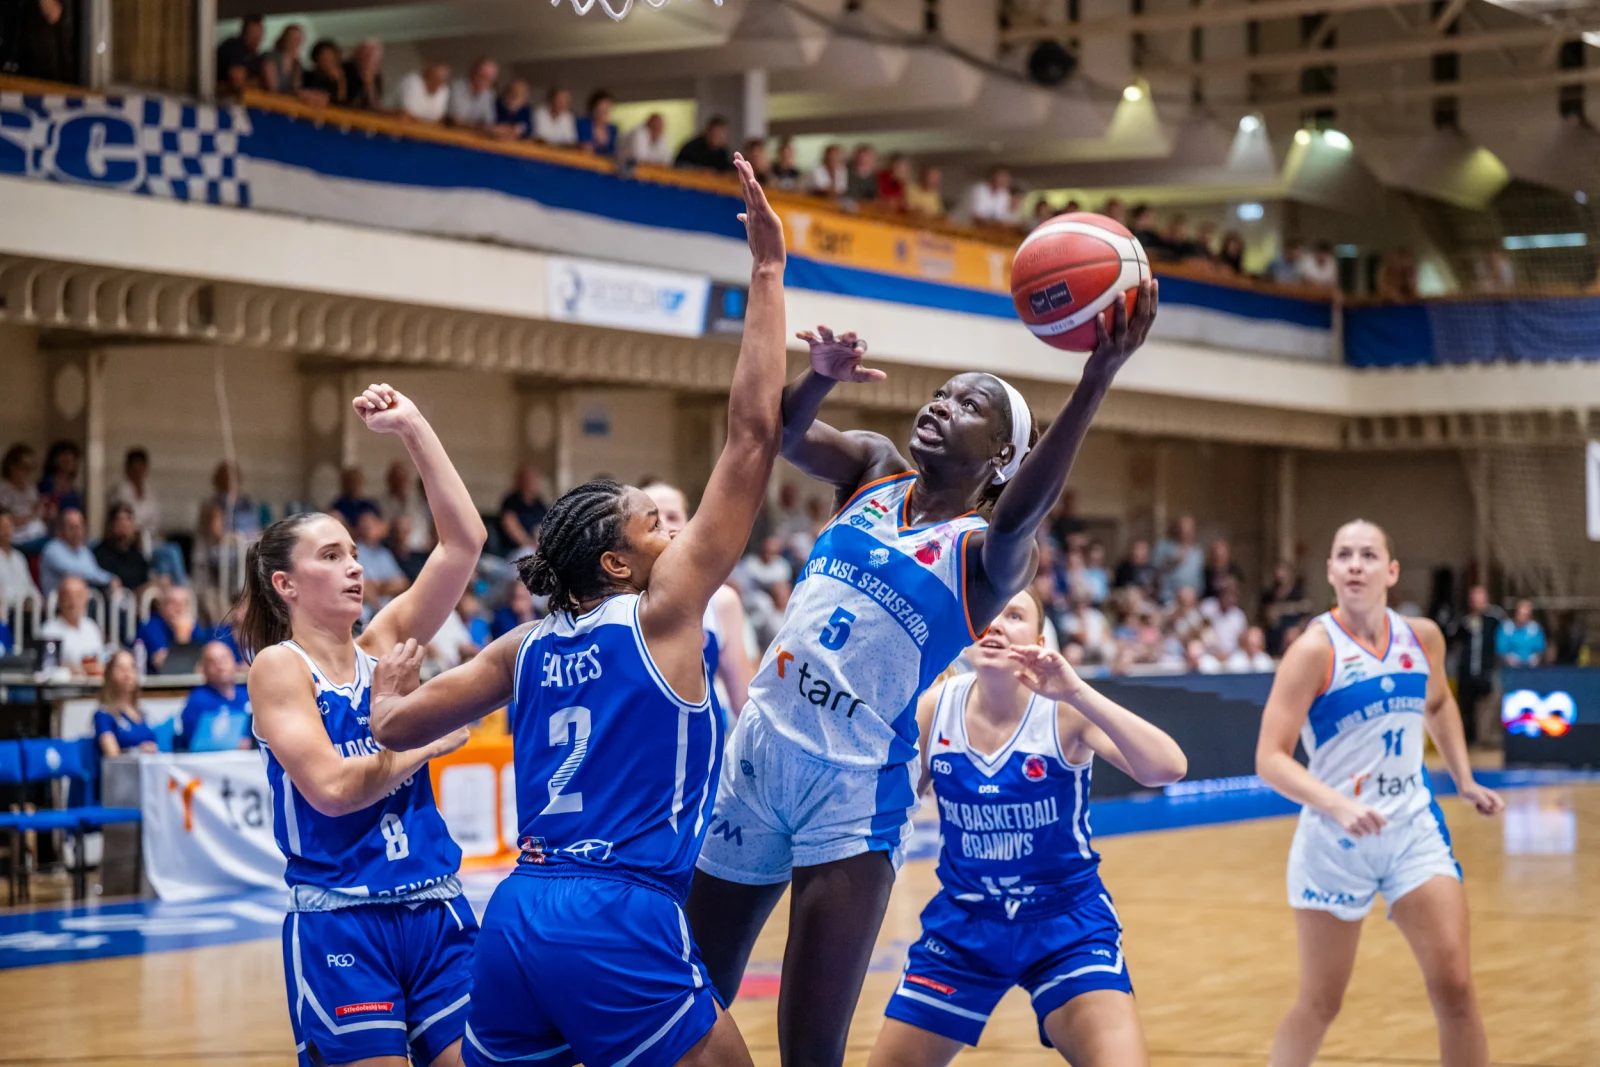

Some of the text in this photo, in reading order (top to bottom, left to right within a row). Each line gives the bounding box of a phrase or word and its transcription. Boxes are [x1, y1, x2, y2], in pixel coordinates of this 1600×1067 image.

[819, 606, 857, 651] 5
[798, 662, 867, 718] tarr
[539, 705, 592, 816] 2
[1382, 728, 1404, 757] 11
[380, 813, 410, 861] 8
[961, 797, 1059, 831] BASKETBALL
